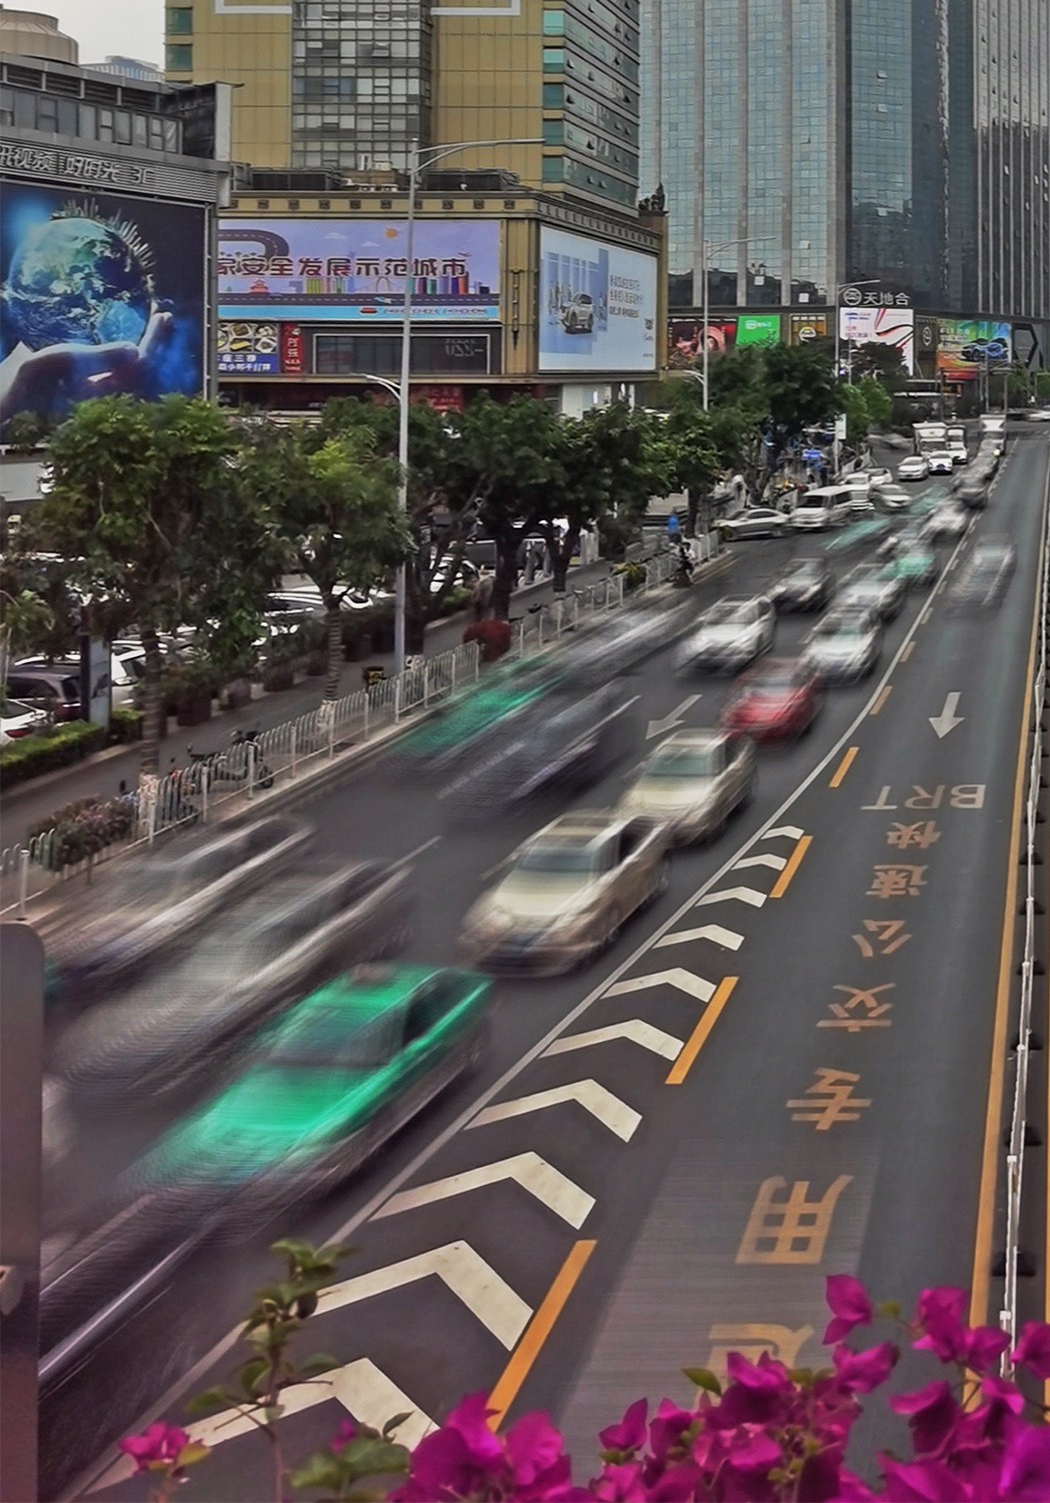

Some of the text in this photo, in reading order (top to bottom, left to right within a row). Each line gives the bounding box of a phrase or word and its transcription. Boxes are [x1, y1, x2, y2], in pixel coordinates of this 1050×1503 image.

[217, 257, 468, 278] 家安全发展示范城市
[863, 291, 911, 306] 天地合
[861, 784, 987, 810] BRT
